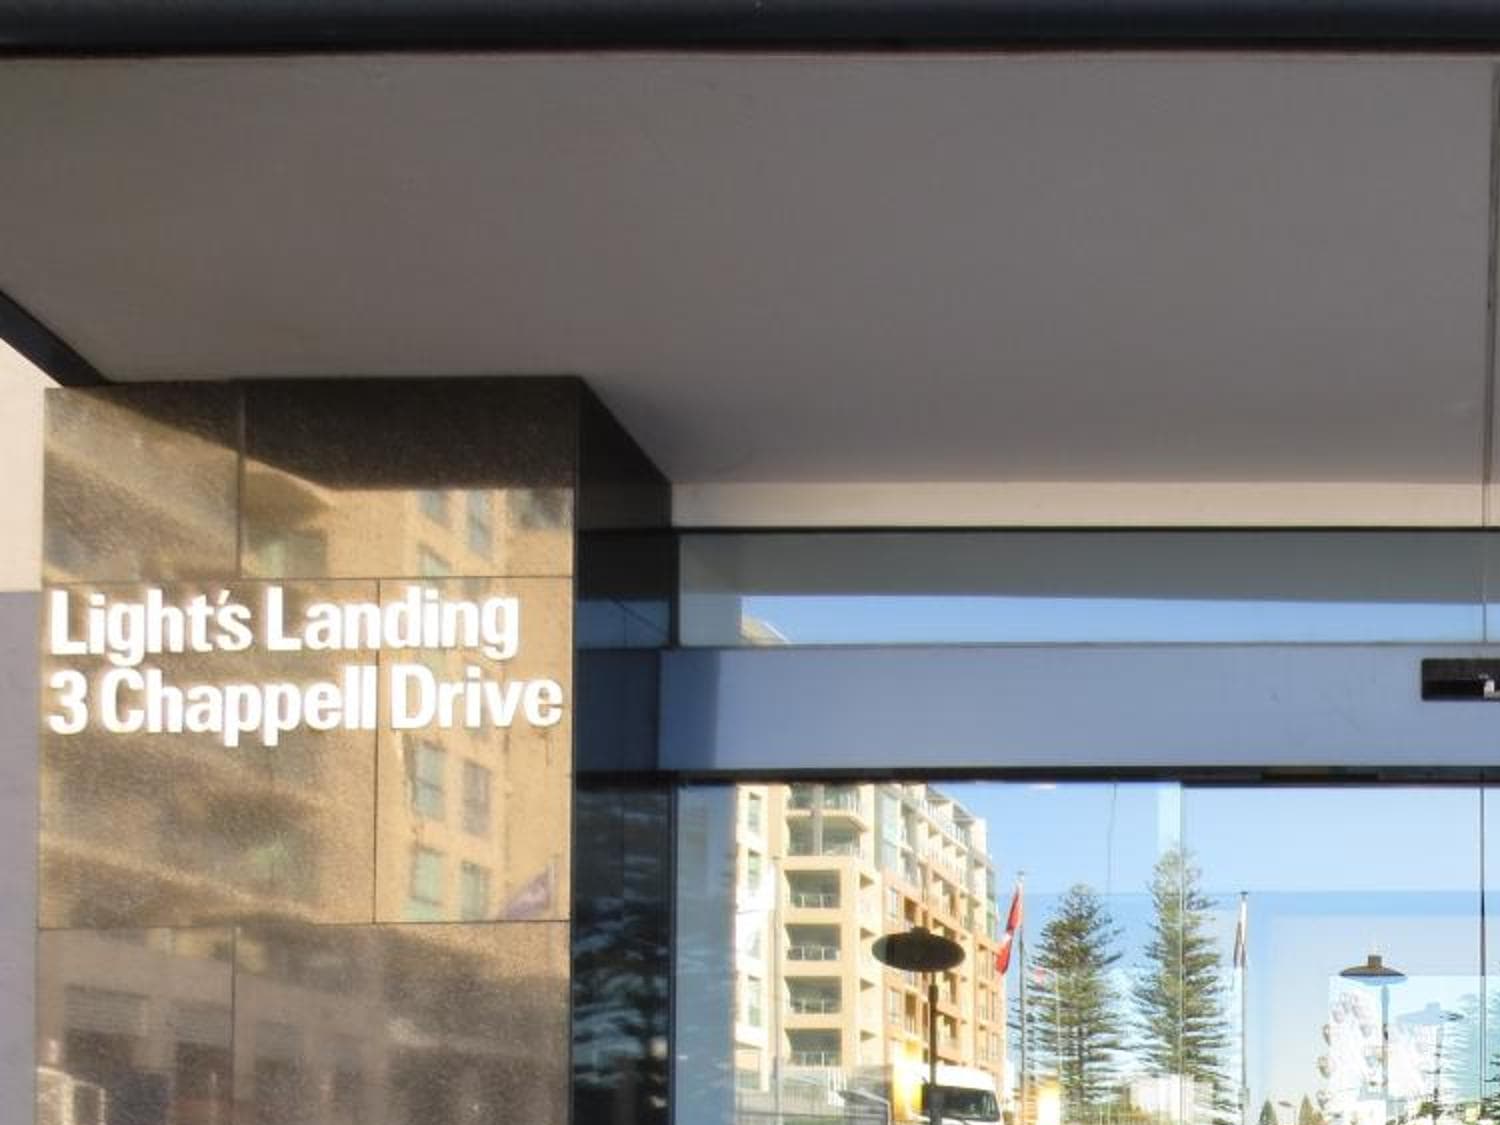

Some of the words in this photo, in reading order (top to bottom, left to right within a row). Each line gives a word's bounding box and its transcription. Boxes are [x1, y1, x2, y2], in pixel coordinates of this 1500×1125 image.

[50, 588, 253, 666] Light's
[265, 585, 520, 660] Landing
[47, 669, 88, 735] 3
[101, 664, 377, 747] Chappell
[390, 662, 563, 729] Drive
